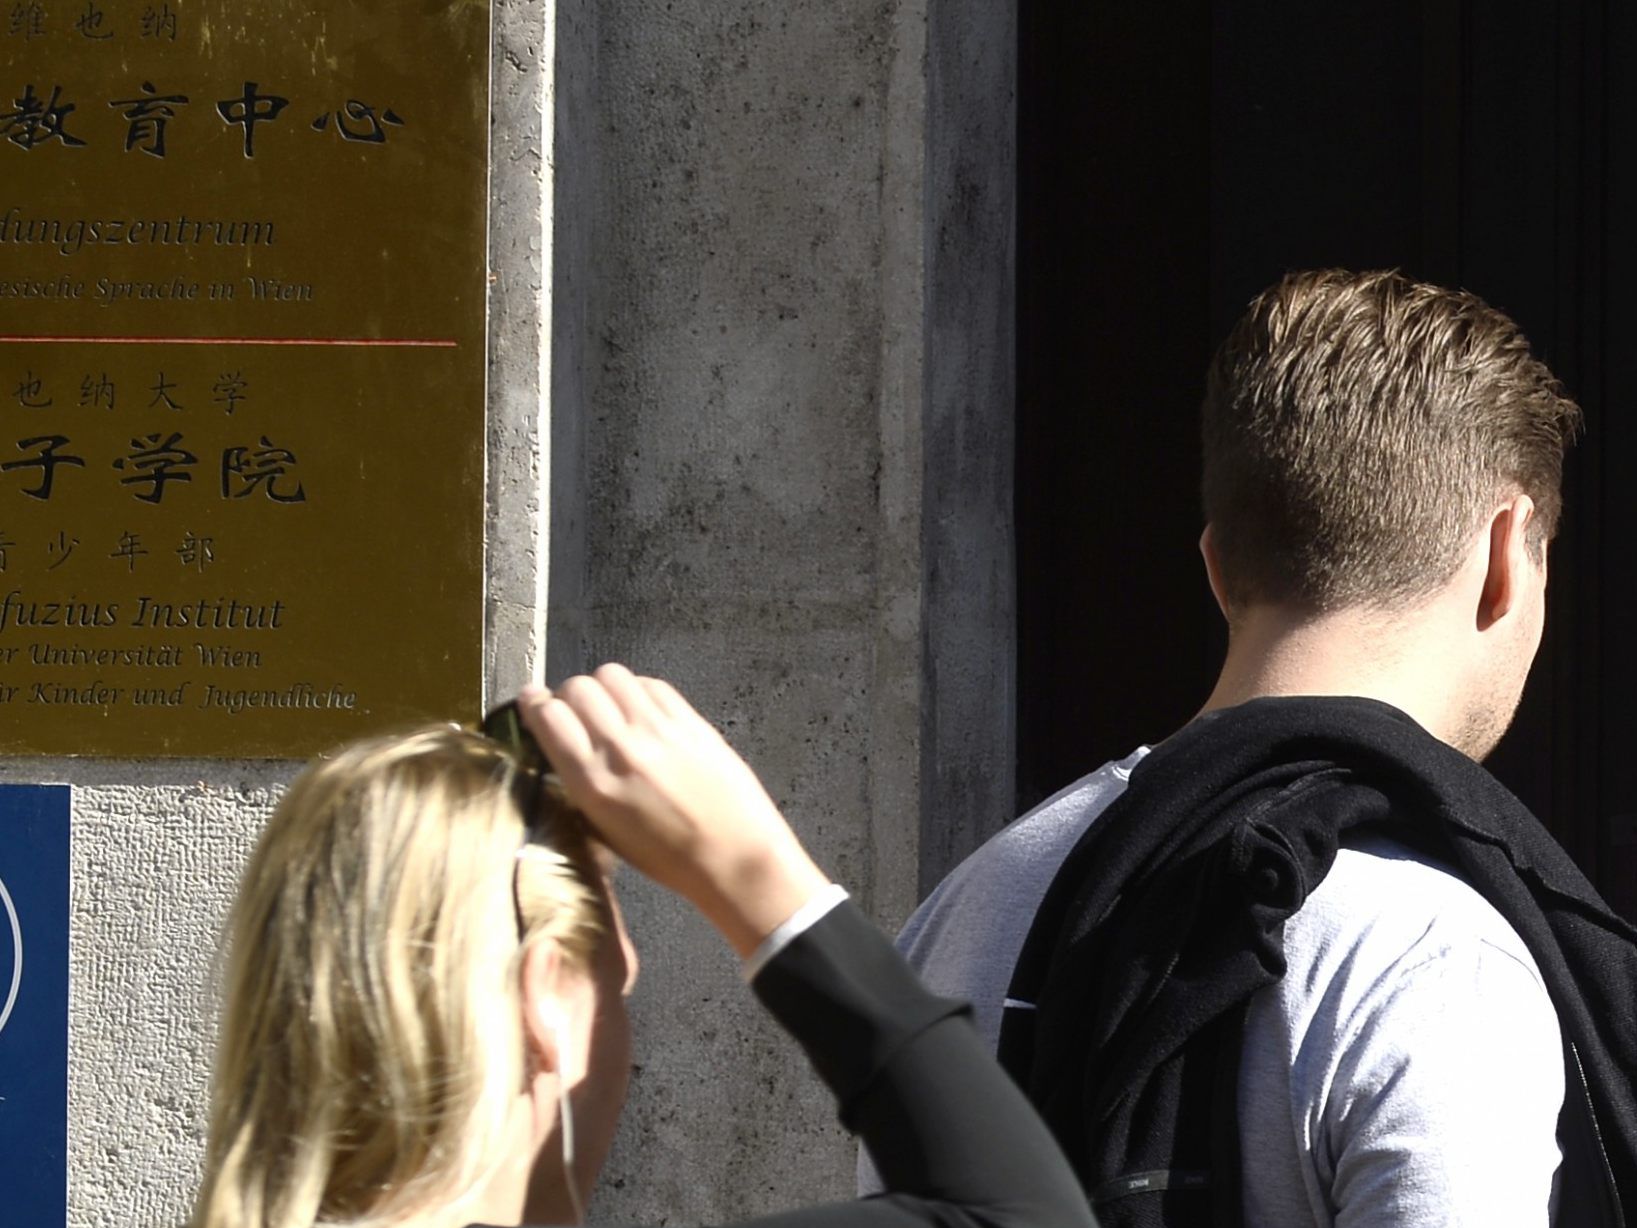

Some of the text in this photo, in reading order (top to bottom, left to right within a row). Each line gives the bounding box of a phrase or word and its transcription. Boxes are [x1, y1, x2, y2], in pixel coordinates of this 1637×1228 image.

[0, 81, 404, 159] 教育中心
[94, 275, 200, 307] Sprache
[208, 279, 235, 300] in
[247, 276, 314, 301] Wien
[1, 432, 306, 504] 子学院
[131, 596, 285, 629] Institut
[29, 642, 184, 667] Universität
[195, 643, 262, 668] Wien
[25, 680, 124, 706] Kinder
[133, 681, 191, 706] und
[198, 682, 358, 714] Jugendliche
